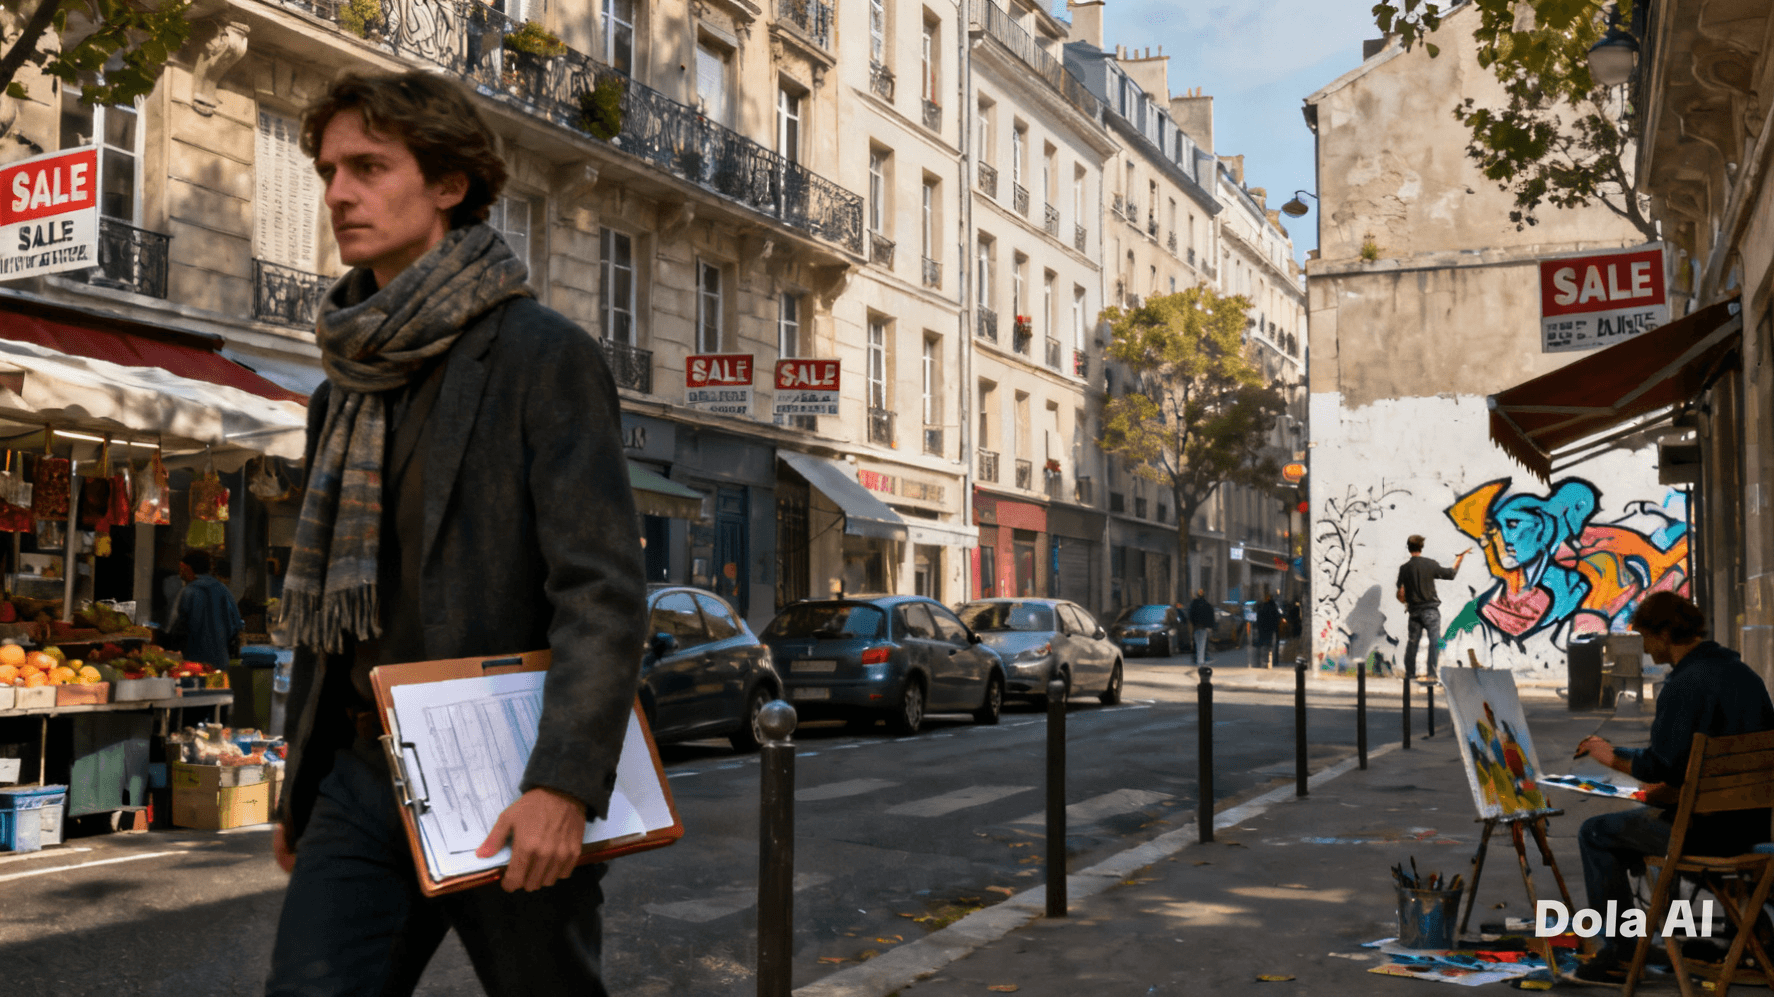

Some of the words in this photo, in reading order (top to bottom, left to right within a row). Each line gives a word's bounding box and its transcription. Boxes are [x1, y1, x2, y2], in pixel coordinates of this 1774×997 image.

[12, 163, 88, 212] SALE
[18, 220, 74, 251] SALE
[1553, 261, 1653, 306] SALE
[692, 359, 748, 382] SALE
[780, 363, 836, 387] SALE
